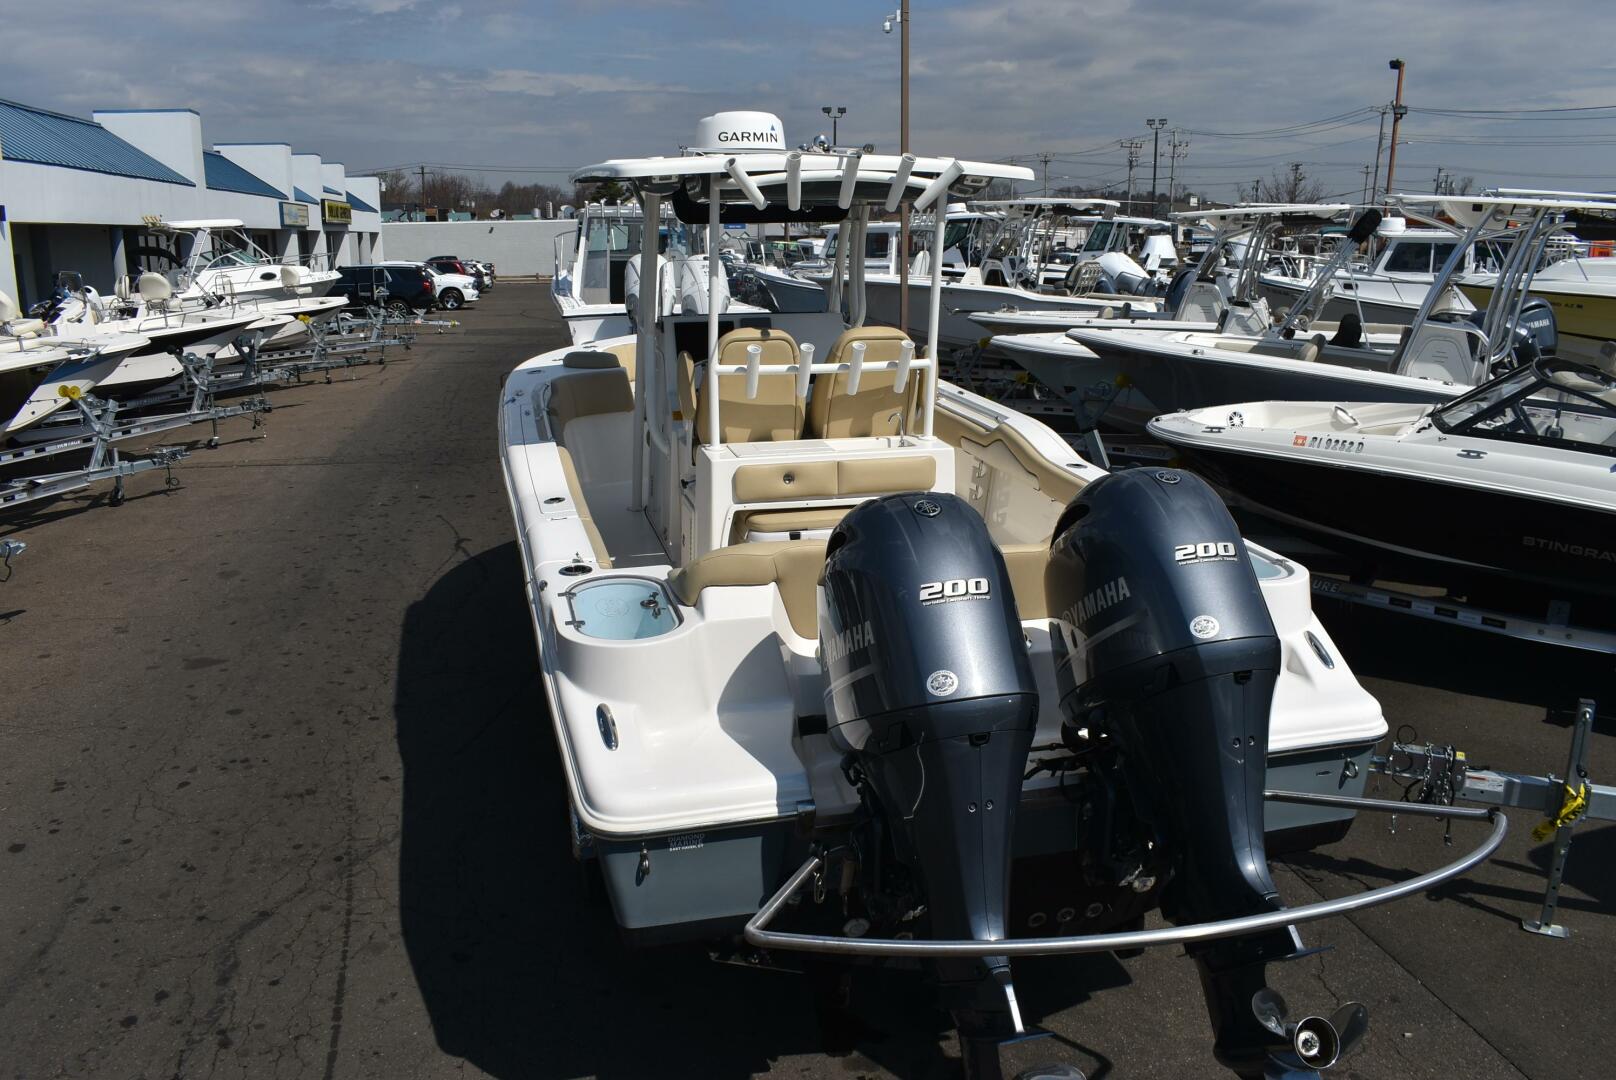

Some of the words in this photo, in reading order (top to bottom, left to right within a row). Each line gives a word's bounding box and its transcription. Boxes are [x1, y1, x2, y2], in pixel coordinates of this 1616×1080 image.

[718, 131, 778, 143] GARMIN
[1527, 318, 1550, 329] YAMAHA
[1175, 542, 1236, 561] 200
[920, 578, 990, 601] 200
[1071, 576, 1131, 627] YAMAHA
